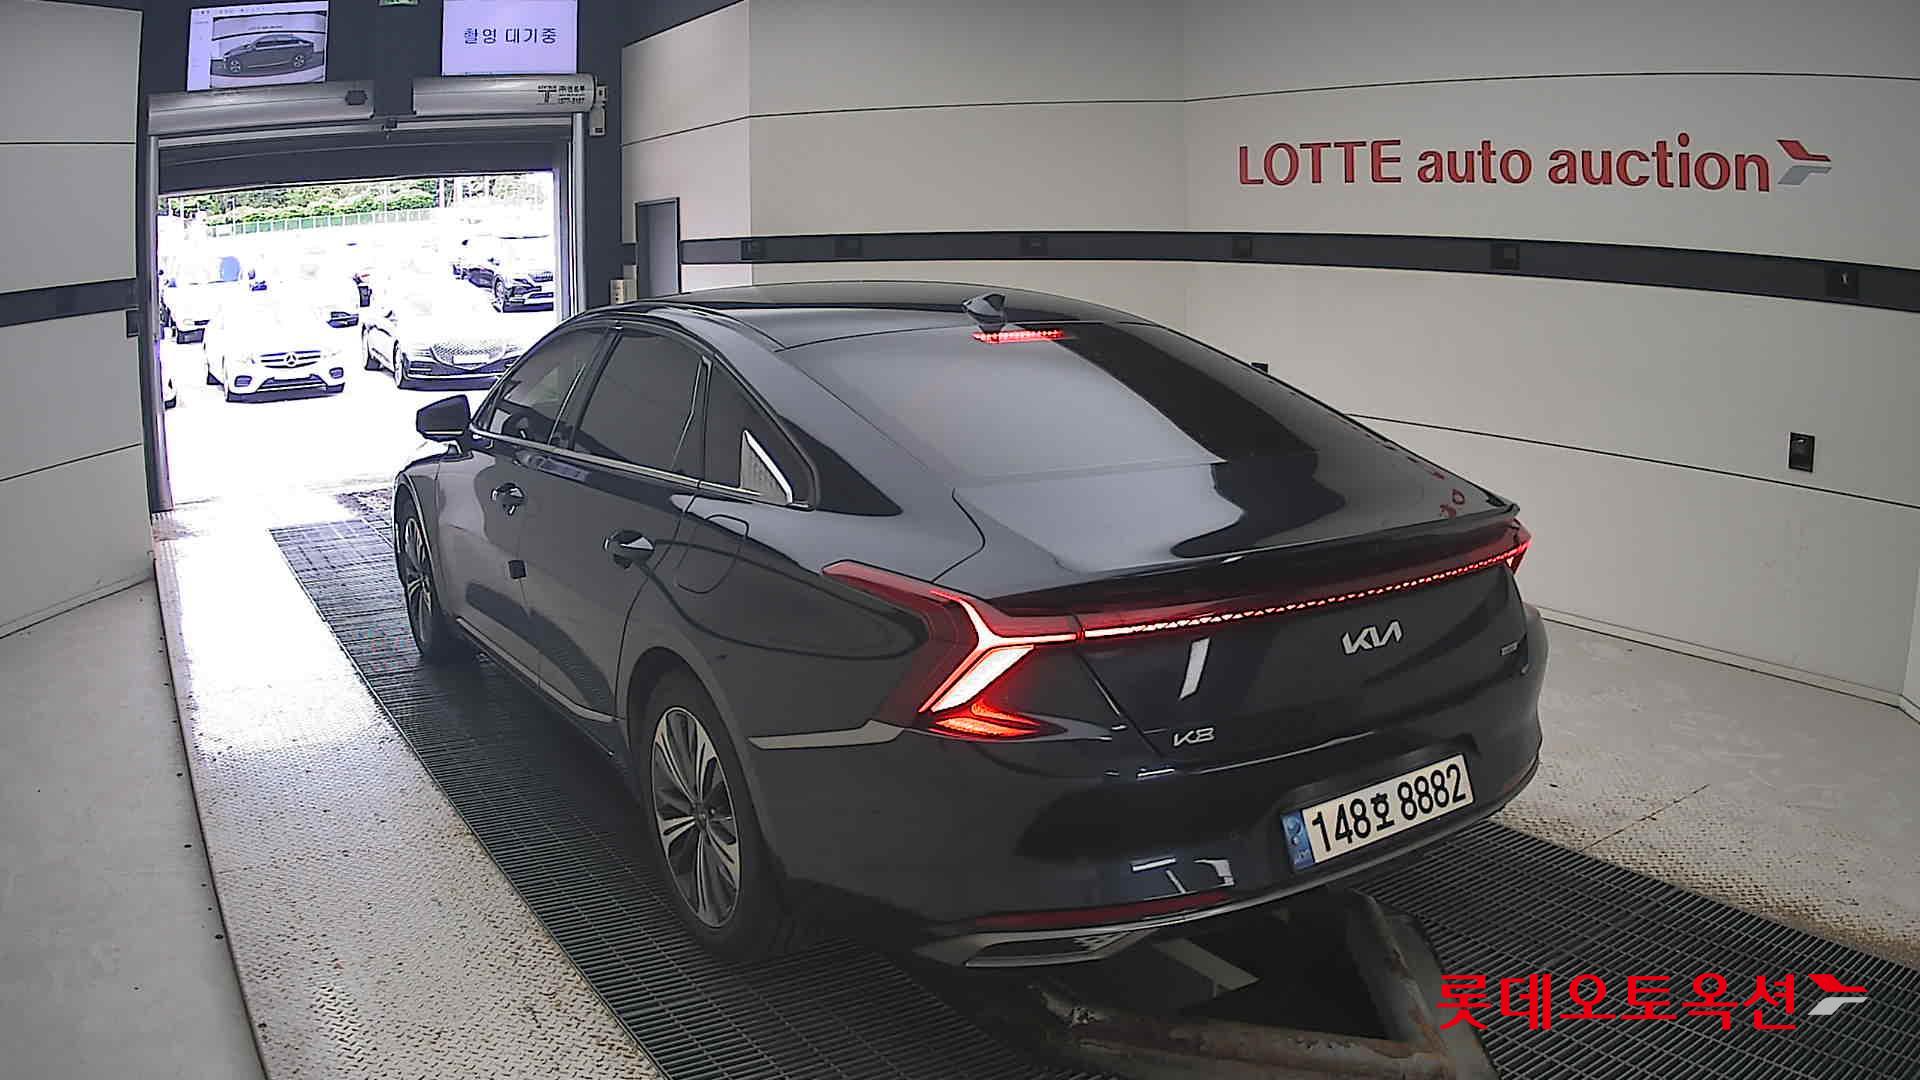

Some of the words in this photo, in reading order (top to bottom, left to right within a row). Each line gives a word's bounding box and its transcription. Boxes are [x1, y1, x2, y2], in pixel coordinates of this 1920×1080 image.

[505, 27, 557, 44] 대기중
[1239, 139, 1401, 185] LOTTE
[1416, 139, 1532, 185] auto
[1548, 132, 1770, 192] auction
[1342, 621, 1402, 655] KIA
[1173, 727, 1214, 747] K8
[1397, 763, 1467, 820] 8882
